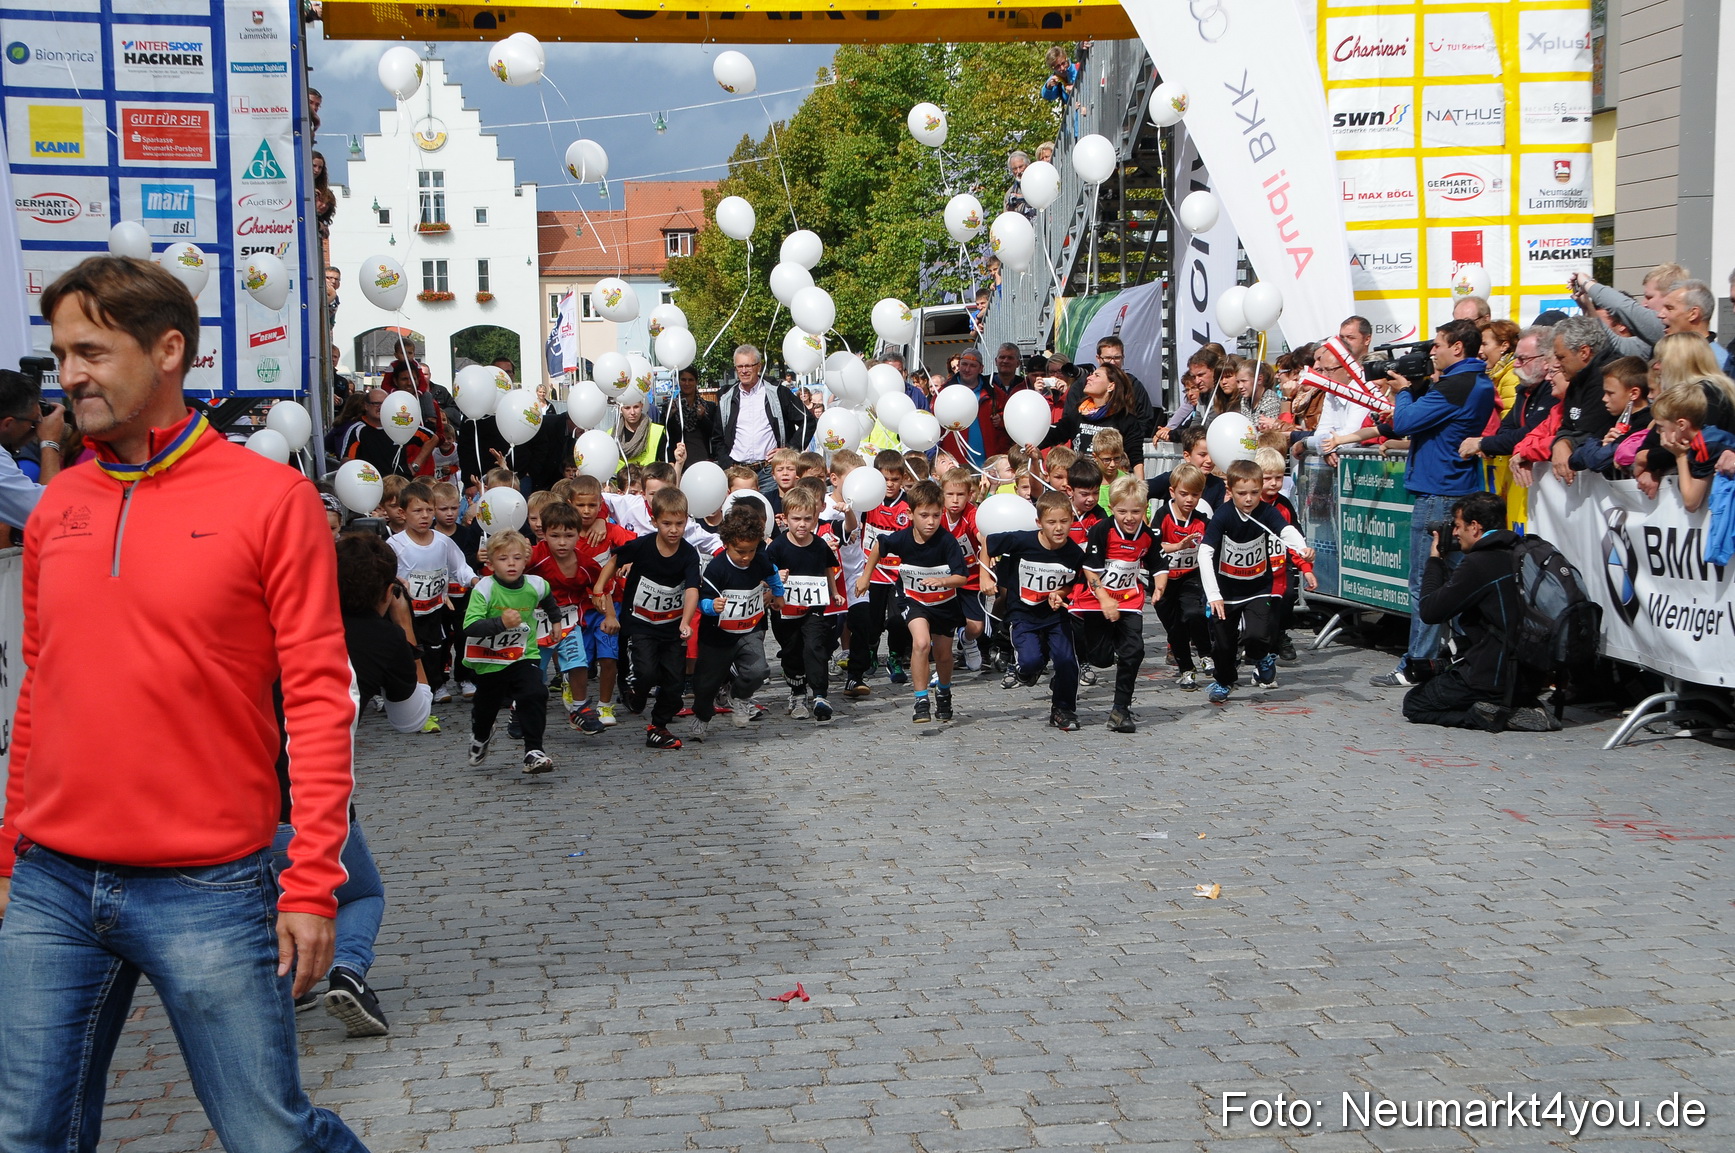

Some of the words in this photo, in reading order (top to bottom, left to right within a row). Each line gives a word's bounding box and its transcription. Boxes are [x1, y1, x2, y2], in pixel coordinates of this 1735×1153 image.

[239, 32, 278, 40] Lammsbräu
[1526, 32, 1591, 54] Xplus1
[135, 41, 203, 52] INTERSPORT
[1333, 35, 1409, 62] Charivari
[35, 48, 95, 62] Bionorica
[124, 52, 204, 66] HACKNER
[232, 64, 264, 72] Neumarkter
[131, 113, 154, 124] GUT
[156, 113, 177, 125] FÜR
[180, 115, 202, 126] SIE!
[1332, 111, 1385, 127] swn
[1427, 108, 1501, 126] NATHUS
[142, 136, 174, 144] Sparkasse
[35, 141, 80, 154] KANN
[143, 145, 203, 153] Neumarkt-Parsberg
[1428, 179, 1472, 188] GERHART
[1448, 186, 1480, 195] JANIG
[147, 190, 190, 211] maxi
[1387, 189, 1414, 199] BÖGL
[15, 199, 68, 208] GERHART
[1529, 198, 1588, 209] Lammsbräu
[39, 208, 75, 216] JANIG
[173, 221, 190, 233] dsl
[237, 216, 294, 236] Charivari
[241, 246, 275, 256] swn
[1350, 252, 1412, 270] ATHUS
[1375, 324, 1402, 334] BKK
[1343, 512, 1356, 531] Fun
[1357, 514, 1363, 533] &
[1364, 515, 1386, 537] Action
[1387, 517, 1395, 538] in
[1225, 547, 1262, 567] 7202
[1343, 540, 1370, 563] sicheren
[1371, 545, 1402, 569] Bahnen!
[1644, 526, 1724, 582] BMW
[1020, 563, 1038, 572] PARTL
[640, 581, 656, 593] PARTL
[1025, 572, 1067, 591] 7164
[641, 590, 683, 610] 7133
[784, 587, 821, 604] 7141
[727, 595, 760, 618] 7152
[1650, 593, 1724, 642] Weniger
[476, 633, 521, 648] 7142
